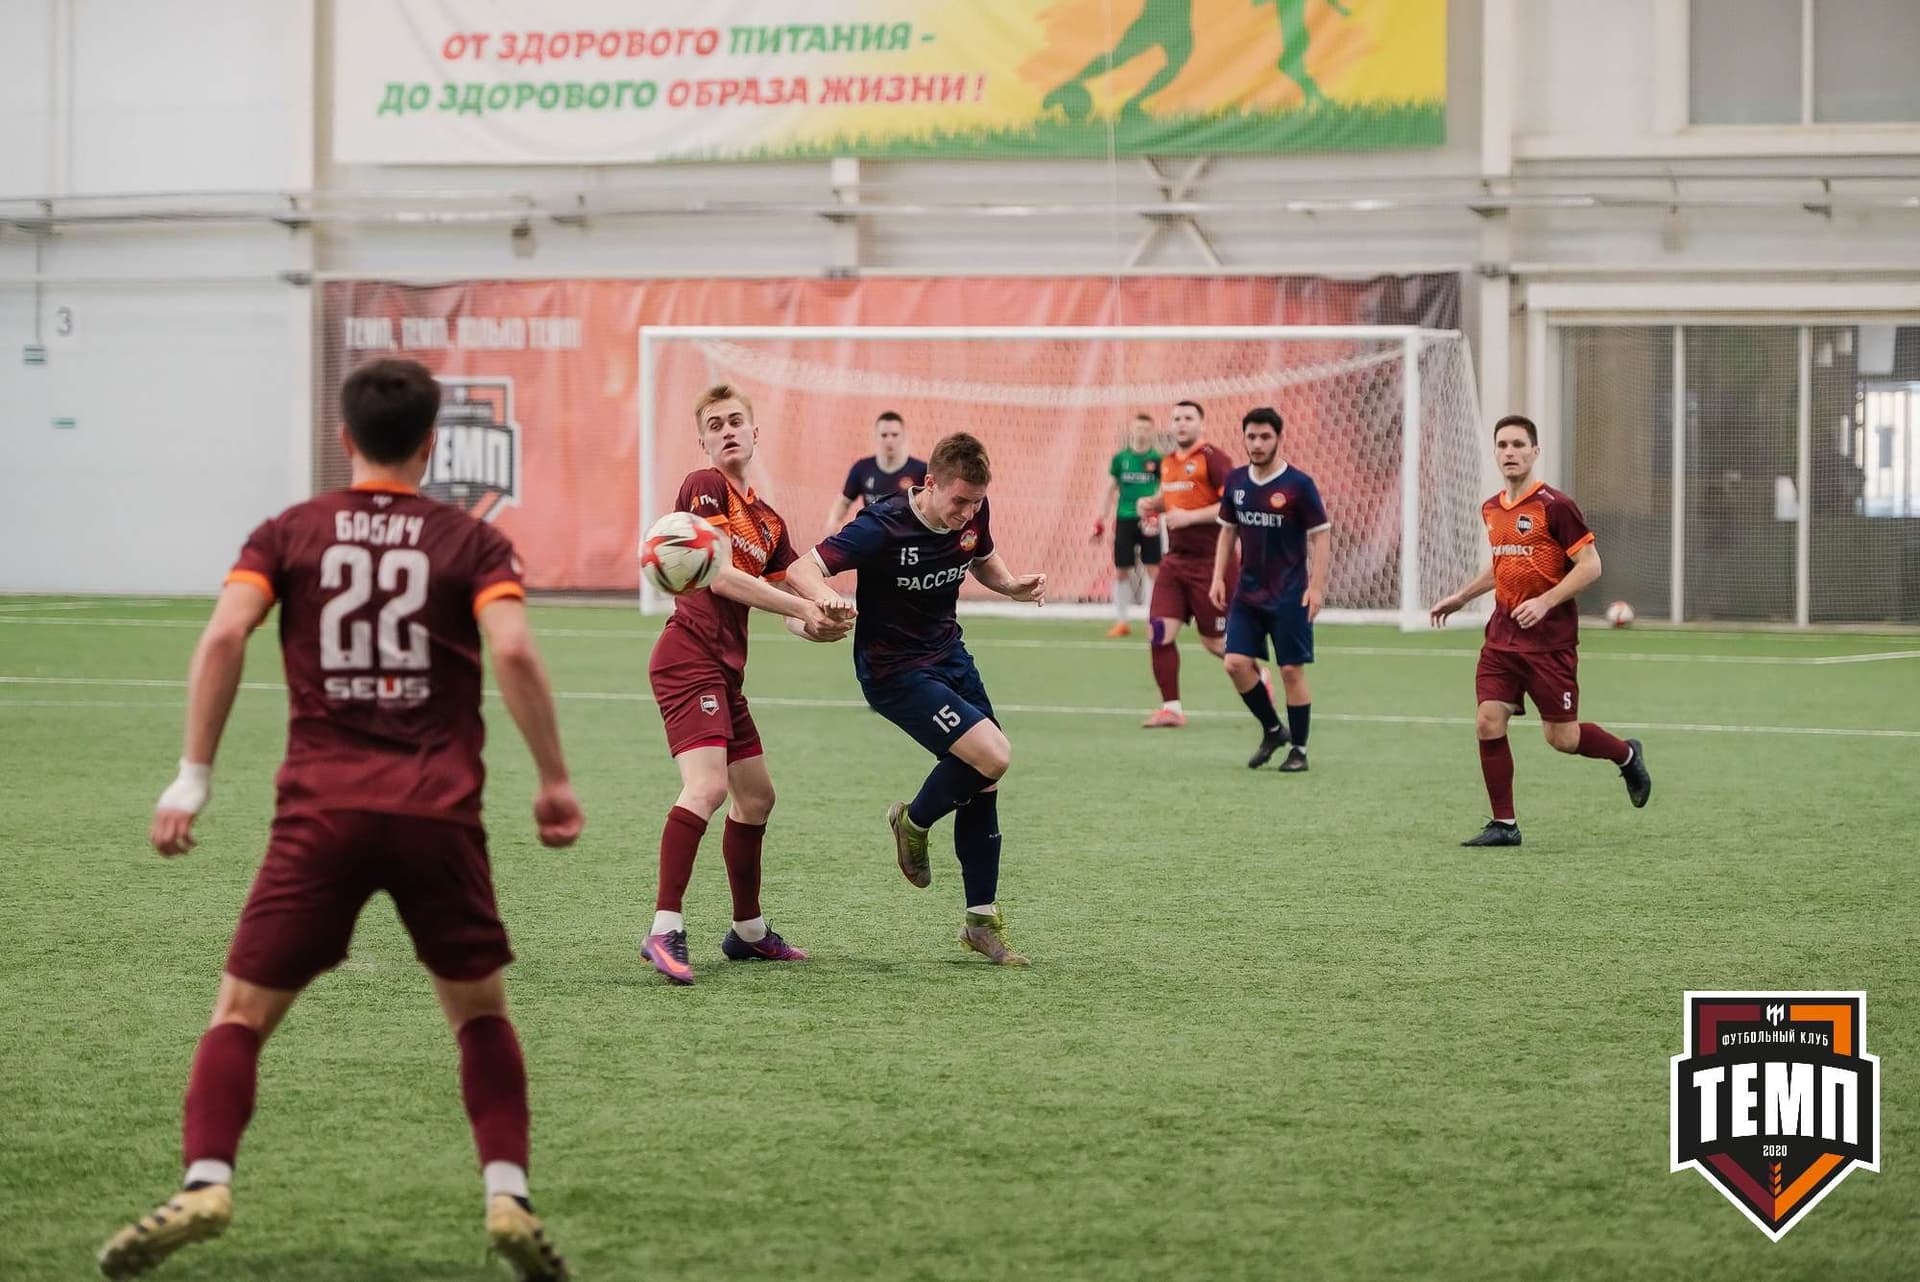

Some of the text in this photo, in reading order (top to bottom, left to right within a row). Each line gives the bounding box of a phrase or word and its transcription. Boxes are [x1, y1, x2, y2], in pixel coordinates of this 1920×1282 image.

[441, 32, 490, 61] ОТ
[496, 28, 719, 65] ЗДОРОВОГО
[728, 22, 913, 54] ПИТАНИЯ
[377, 80, 431, 117] ДО
[438, 80, 657, 117] ЗДОРОВОГО
[667, 75, 809, 108] ОБРАЗА
[56, 305, 73, 337] 3
[432, 425, 511, 489] ЕМП
[335, 510, 424, 546] БАБИЧ
[901, 547, 920, 566] 15
[320, 544, 431, 670] 22
[324, 676, 431, 700] SEUS
[932, 704, 961, 734] 15
